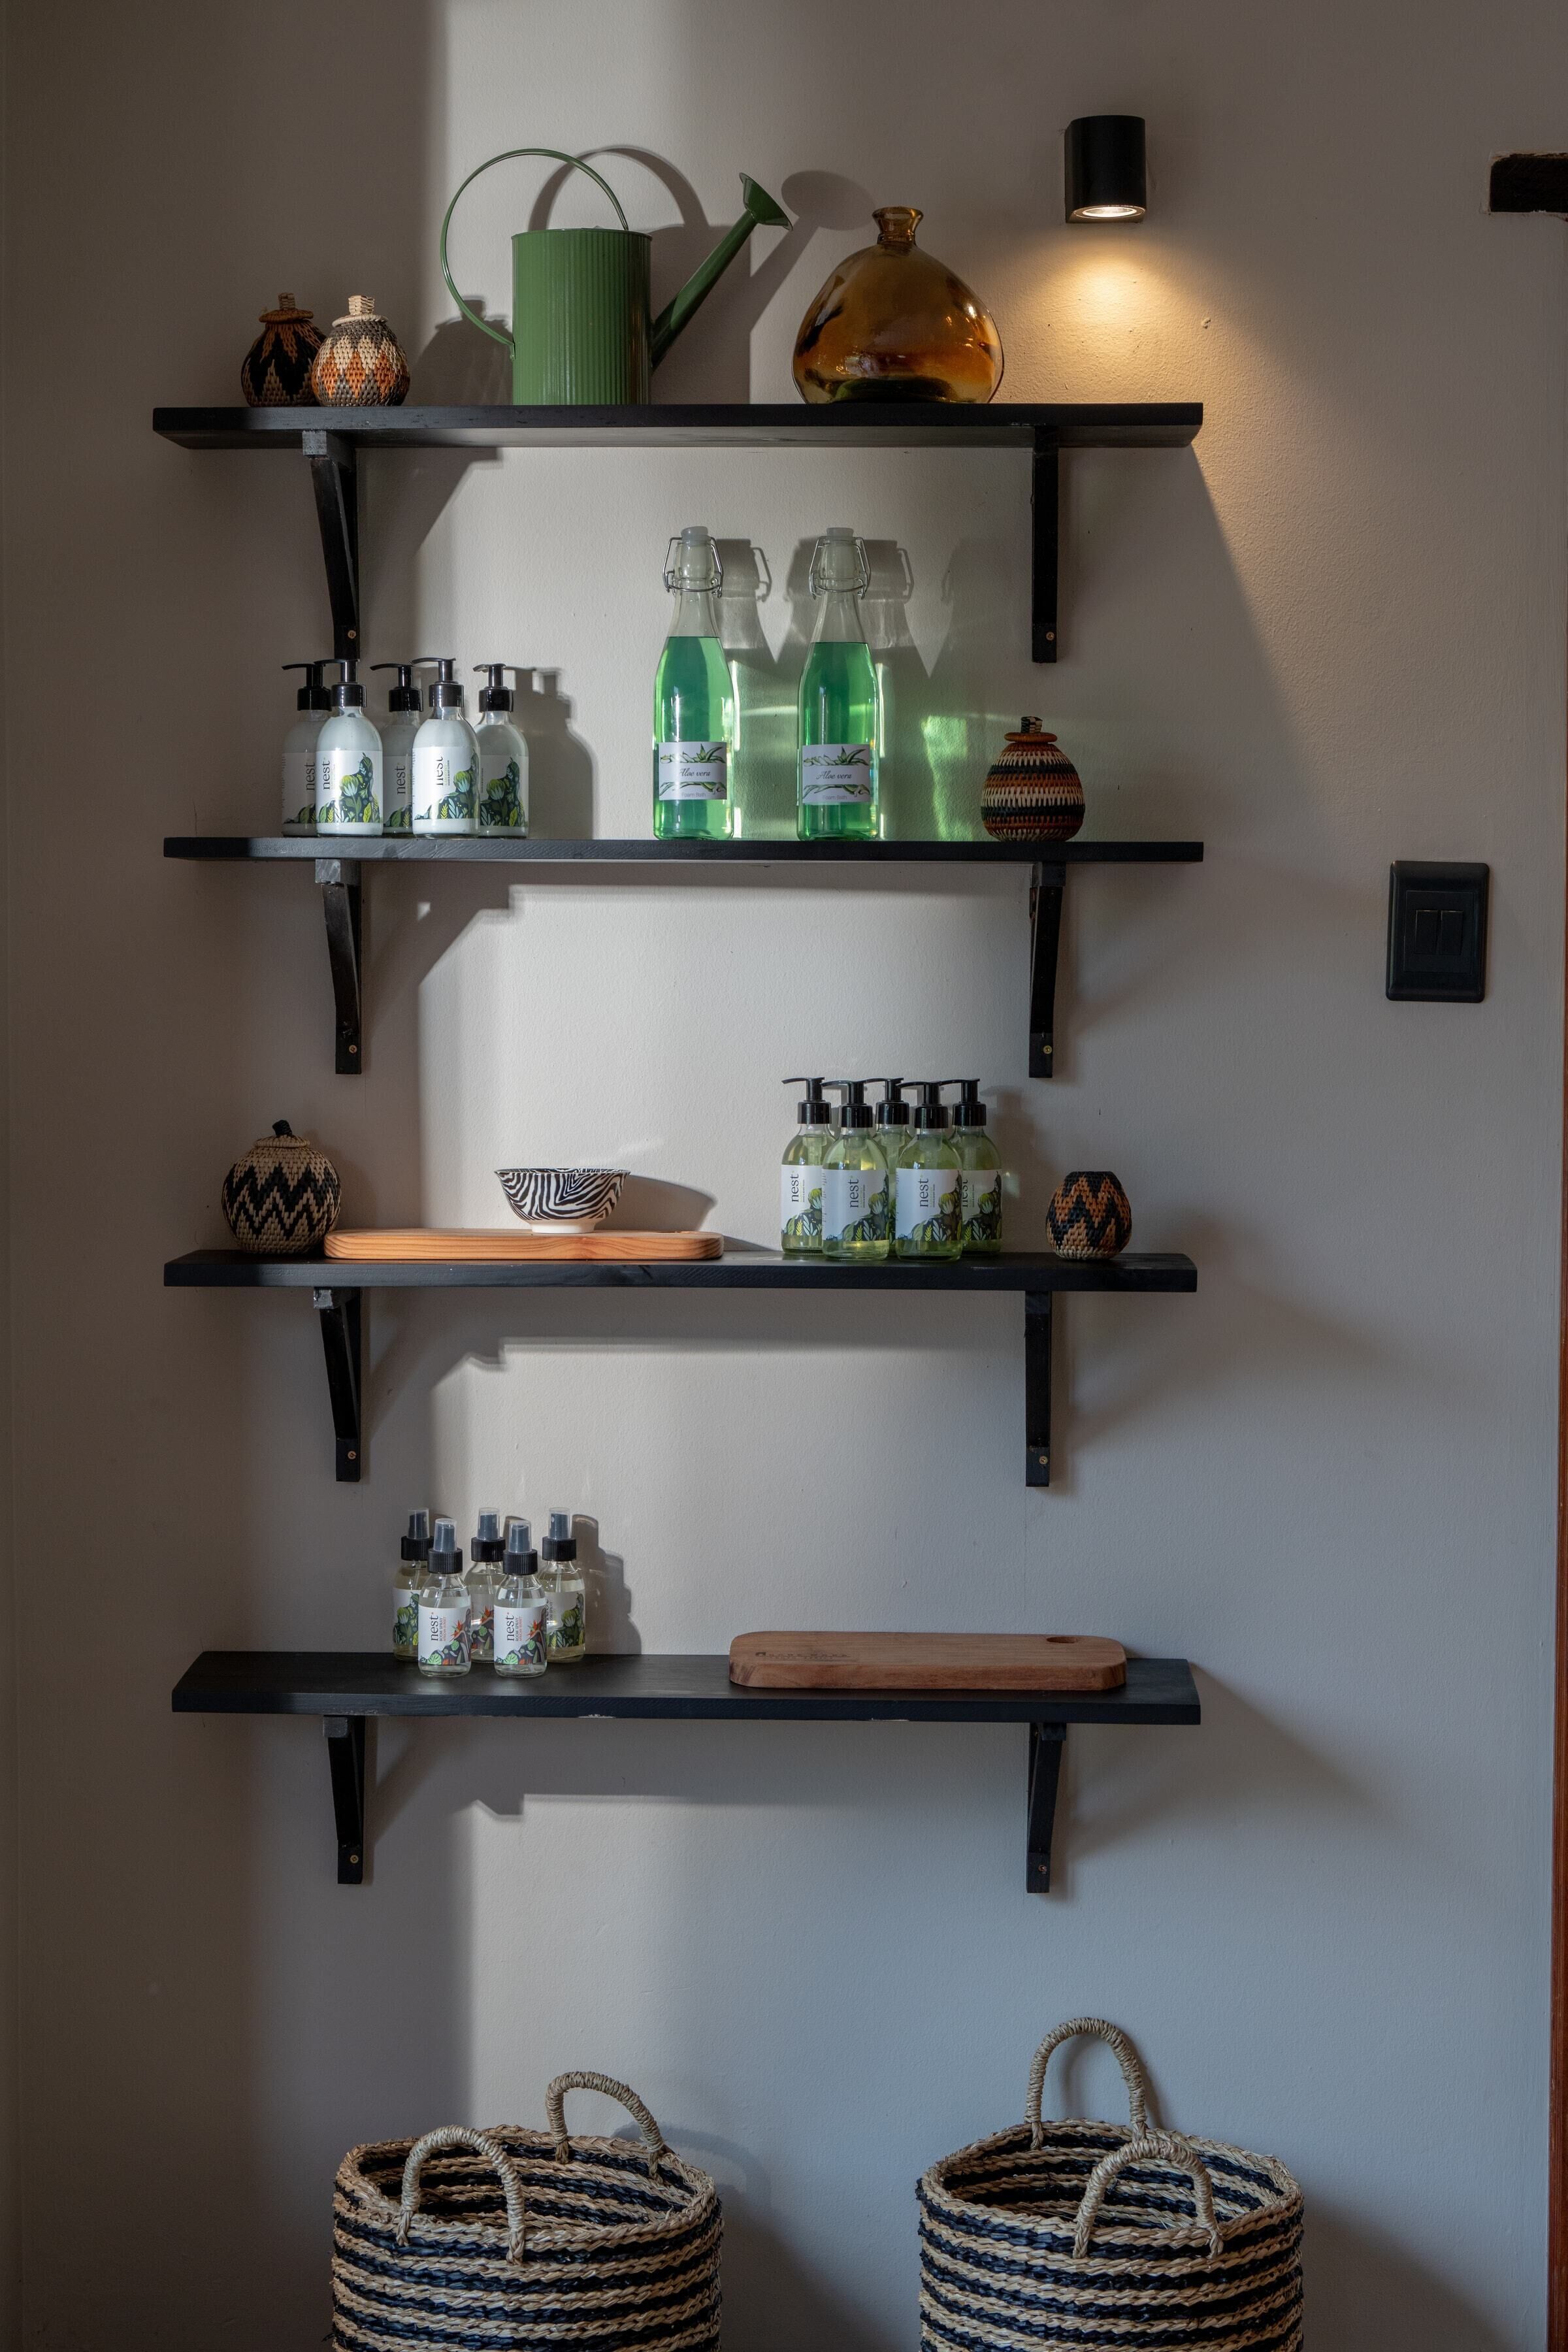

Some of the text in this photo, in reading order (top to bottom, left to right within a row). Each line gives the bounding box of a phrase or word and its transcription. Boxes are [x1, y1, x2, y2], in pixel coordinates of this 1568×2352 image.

[304, 762, 315, 791] nest
[321, 760, 331, 790] nest
[395, 766, 406, 794] nest
[679, 768, 694, 777] Aloe
[816, 770, 836, 779] Aloe
[790, 1173, 799, 1202] nest
[848, 1179, 858, 1208] nest
[917, 1178, 928, 1207] nest
[429, 1615, 438, 1641] nest
[505, 1615, 514, 1641] nest
